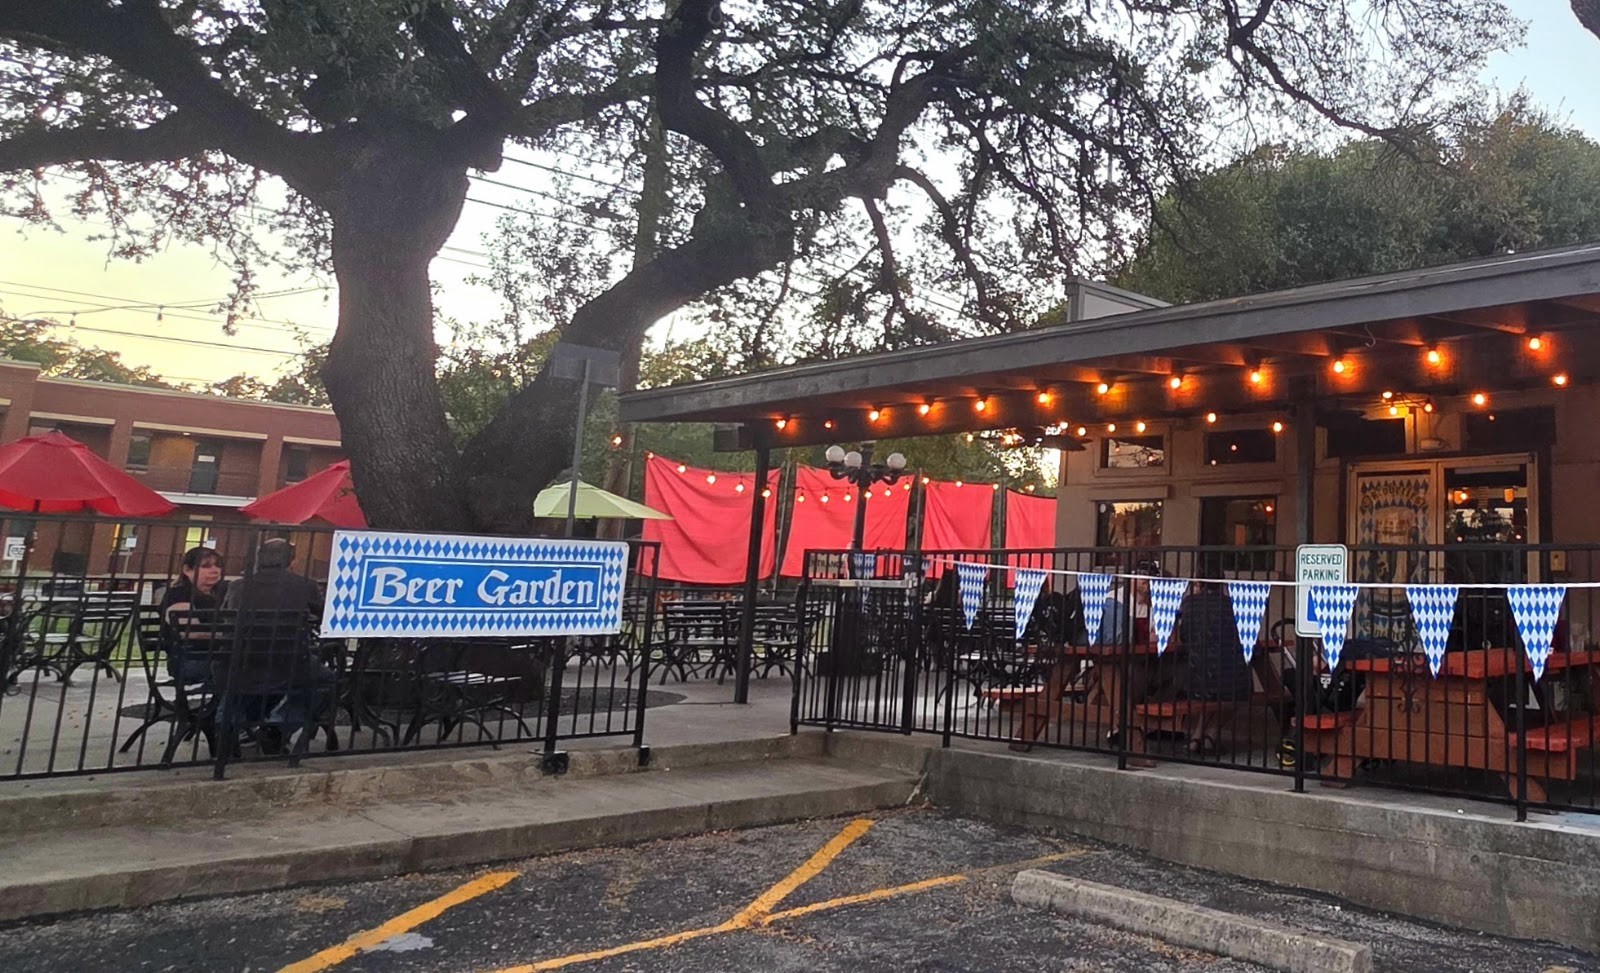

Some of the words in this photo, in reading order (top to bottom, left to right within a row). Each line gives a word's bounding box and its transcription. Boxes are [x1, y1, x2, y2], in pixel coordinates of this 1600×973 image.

[1300, 553, 1342, 565] RESERVED
[1302, 569, 1340, 580] PARKING
[368, 566, 464, 605] Beer
[476, 568, 595, 606] Garden
